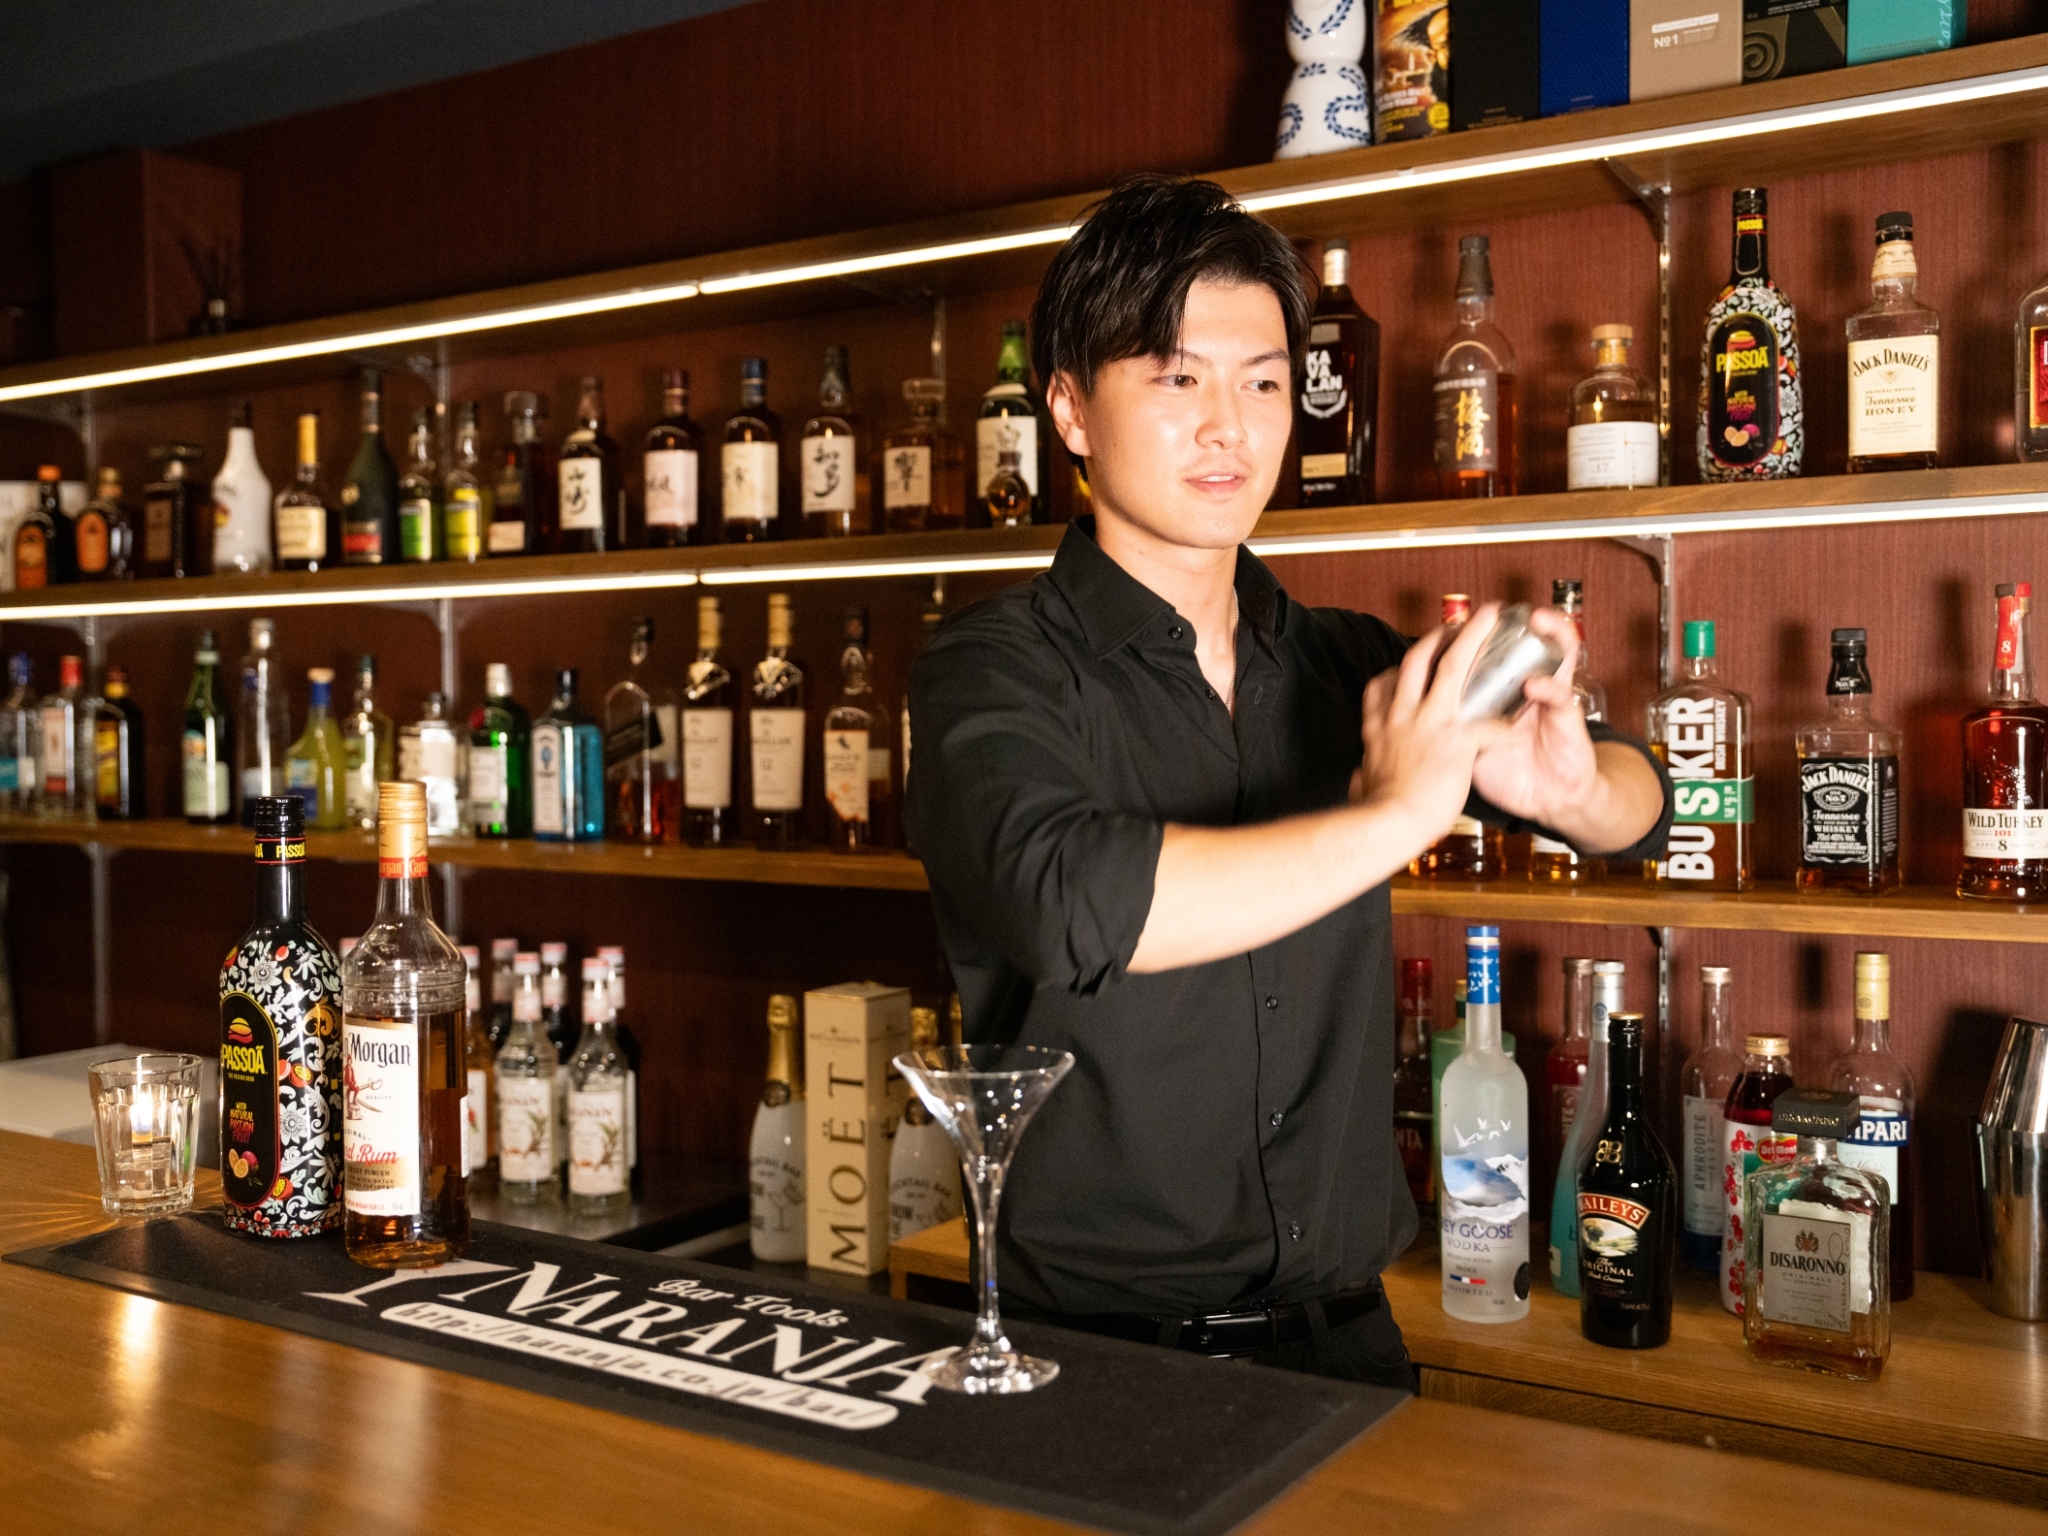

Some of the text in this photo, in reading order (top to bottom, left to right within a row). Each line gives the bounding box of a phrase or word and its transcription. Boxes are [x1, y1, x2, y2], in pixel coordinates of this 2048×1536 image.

[1853, 348, 1931, 378] JACK DANIEL'S
[1306, 375, 1342, 393] LAN
[1865, 395, 1916, 407] Tennessee
[1865, 405, 1917, 416] HONEY
[1454, 387, 1491, 461] 梅酒
[2001, 640, 2012, 653] 8
[1715, 700, 1727, 770] IRISH WHISKEY
[1668, 697, 1720, 880] BUSKER
[1801, 770, 1829, 793] JACK
[1813, 825, 1859, 834] WHISKEY
[1968, 812, 1996, 828] WILD
[1998, 840, 2008, 851] 8
[380, 861, 402, 876] organ
[222, 1043, 265, 1075] PASSOÃ
[349, 1032, 411, 1069] Morgan
[230, 1109, 254, 1122] NATURAL
[230, 1119, 255, 1133] PASSION
[1848, 1120, 1907, 1142] PARI
[357, 1143, 398, 1167] Rum
[1776, 1144, 1797, 1154] Mont
[822, 1062, 868, 1271] MOËT
[1459, 1223, 1514, 1240] GOOSE
[1447, 1236, 1491, 1253] VODKA
[1770, 1251, 1846, 1277] DISARONNO
[648, 1279, 850, 1328] Bar Tools
[437, 1260, 963, 1406] NARANJA
[394, 1302, 892, 1422] http://naranja.co.jp/bar/
